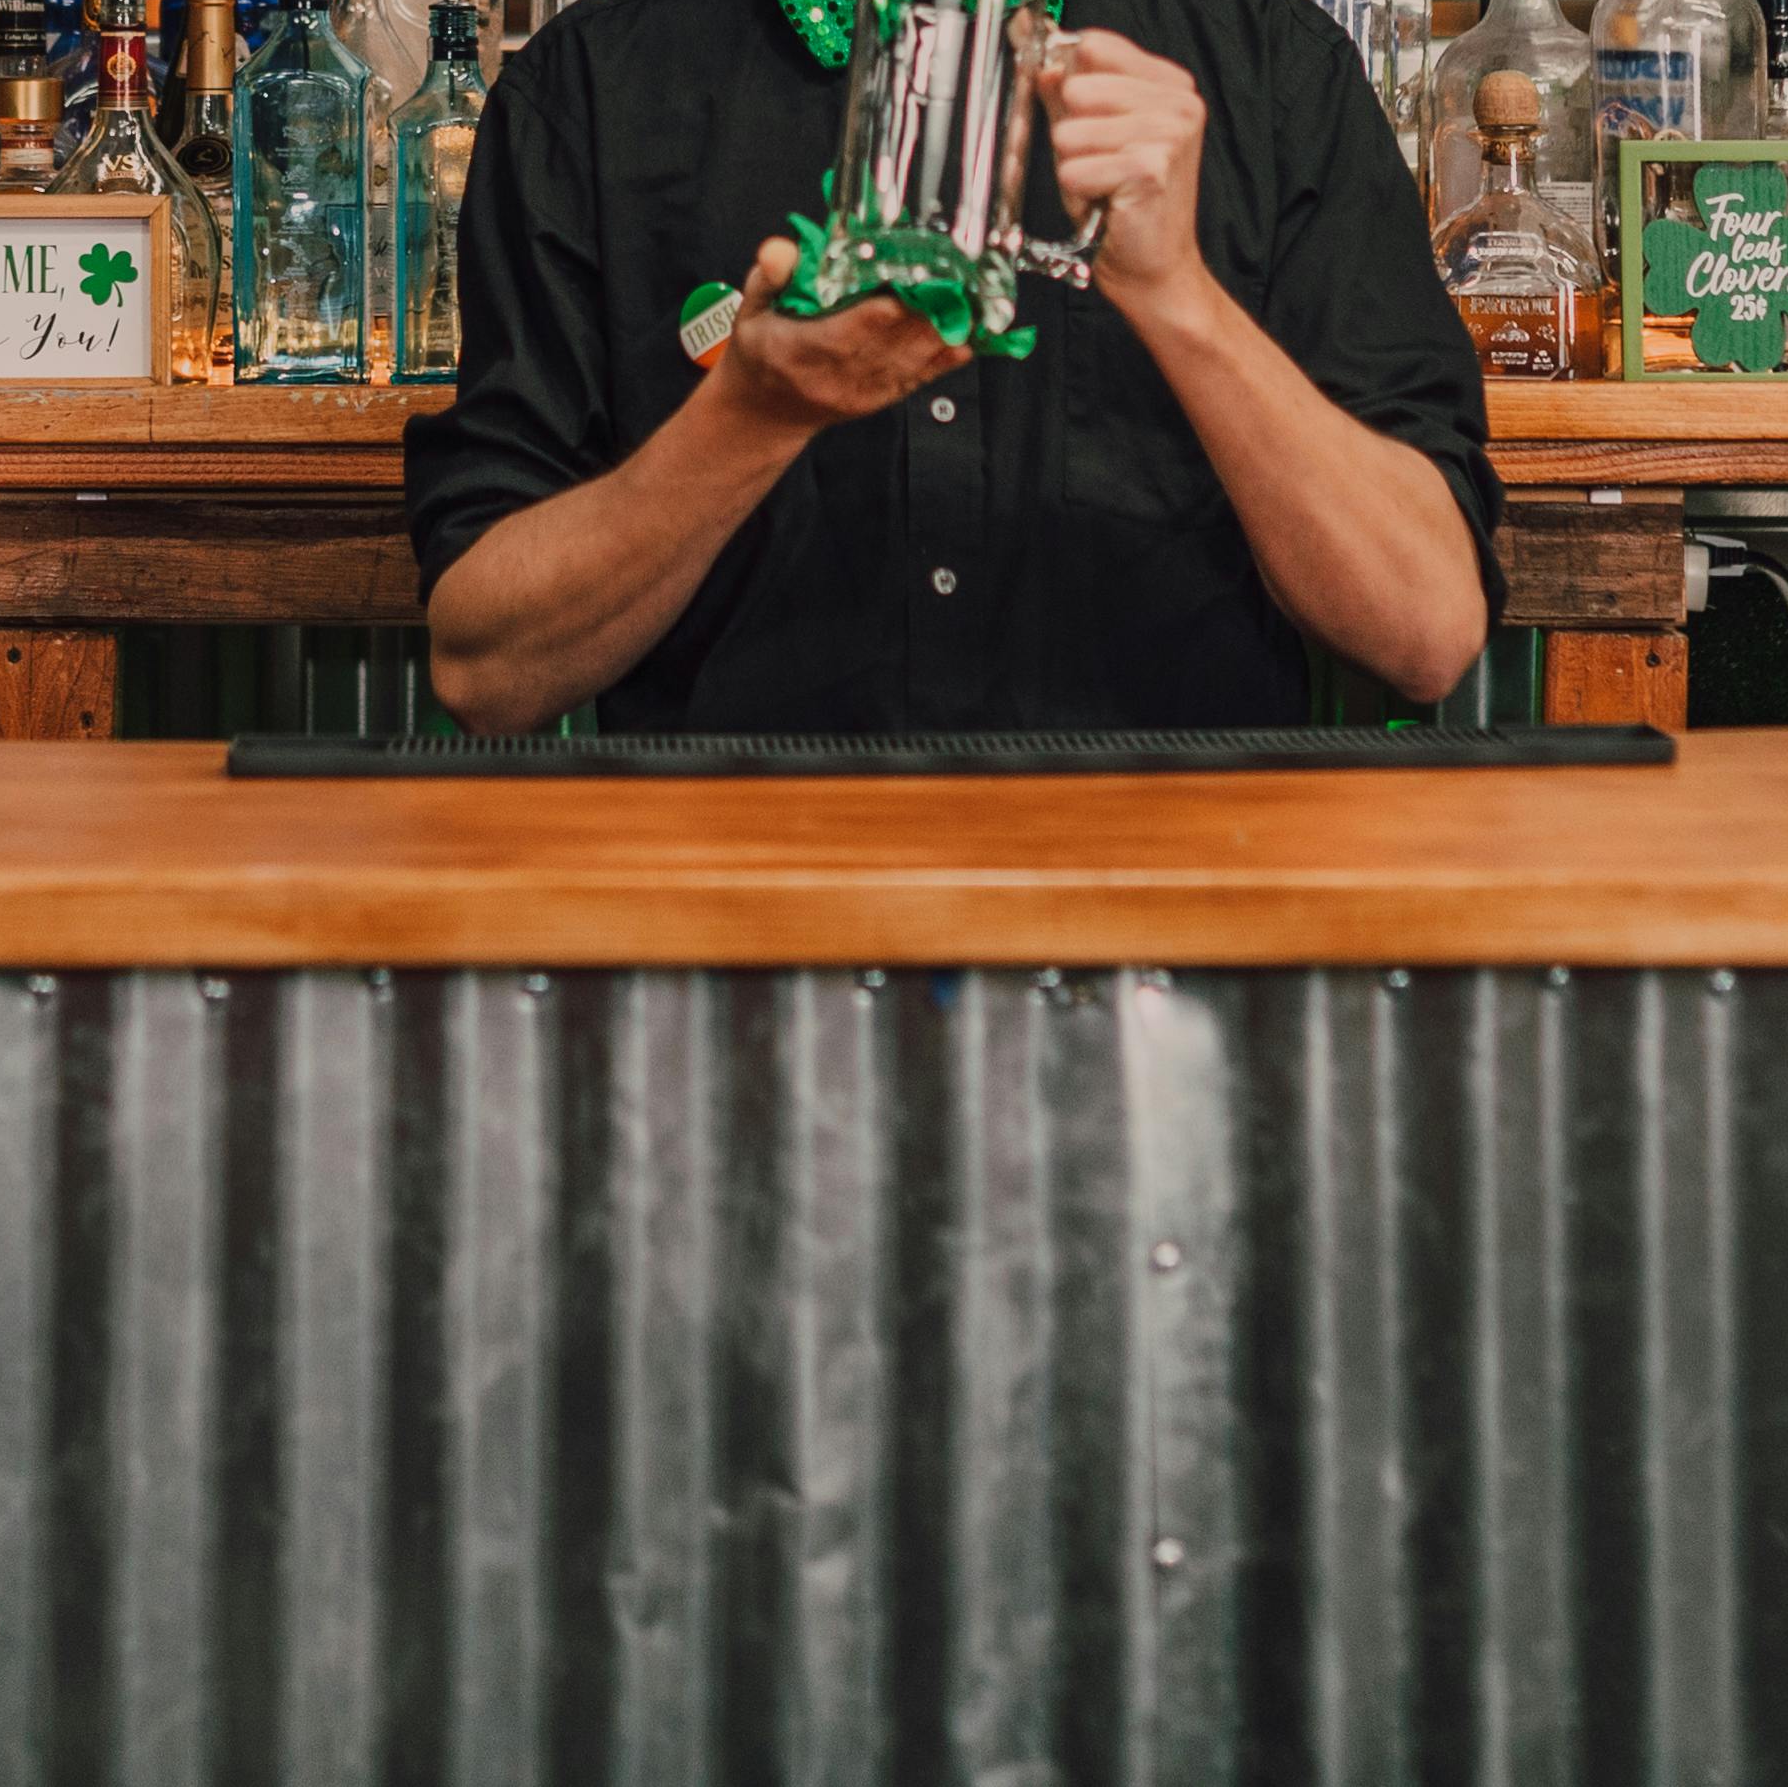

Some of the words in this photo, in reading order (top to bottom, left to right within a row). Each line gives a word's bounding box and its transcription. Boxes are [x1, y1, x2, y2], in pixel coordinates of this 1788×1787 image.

[1704, 192, 1783, 242] Four
[2, 244, 65, 302] ME,
[1731, 234, 1788, 267] leaf
[684, 299, 737, 353] IRISH
[1729, 293, 1769, 322] 25¢
[19, 312, 121, 361] You!
